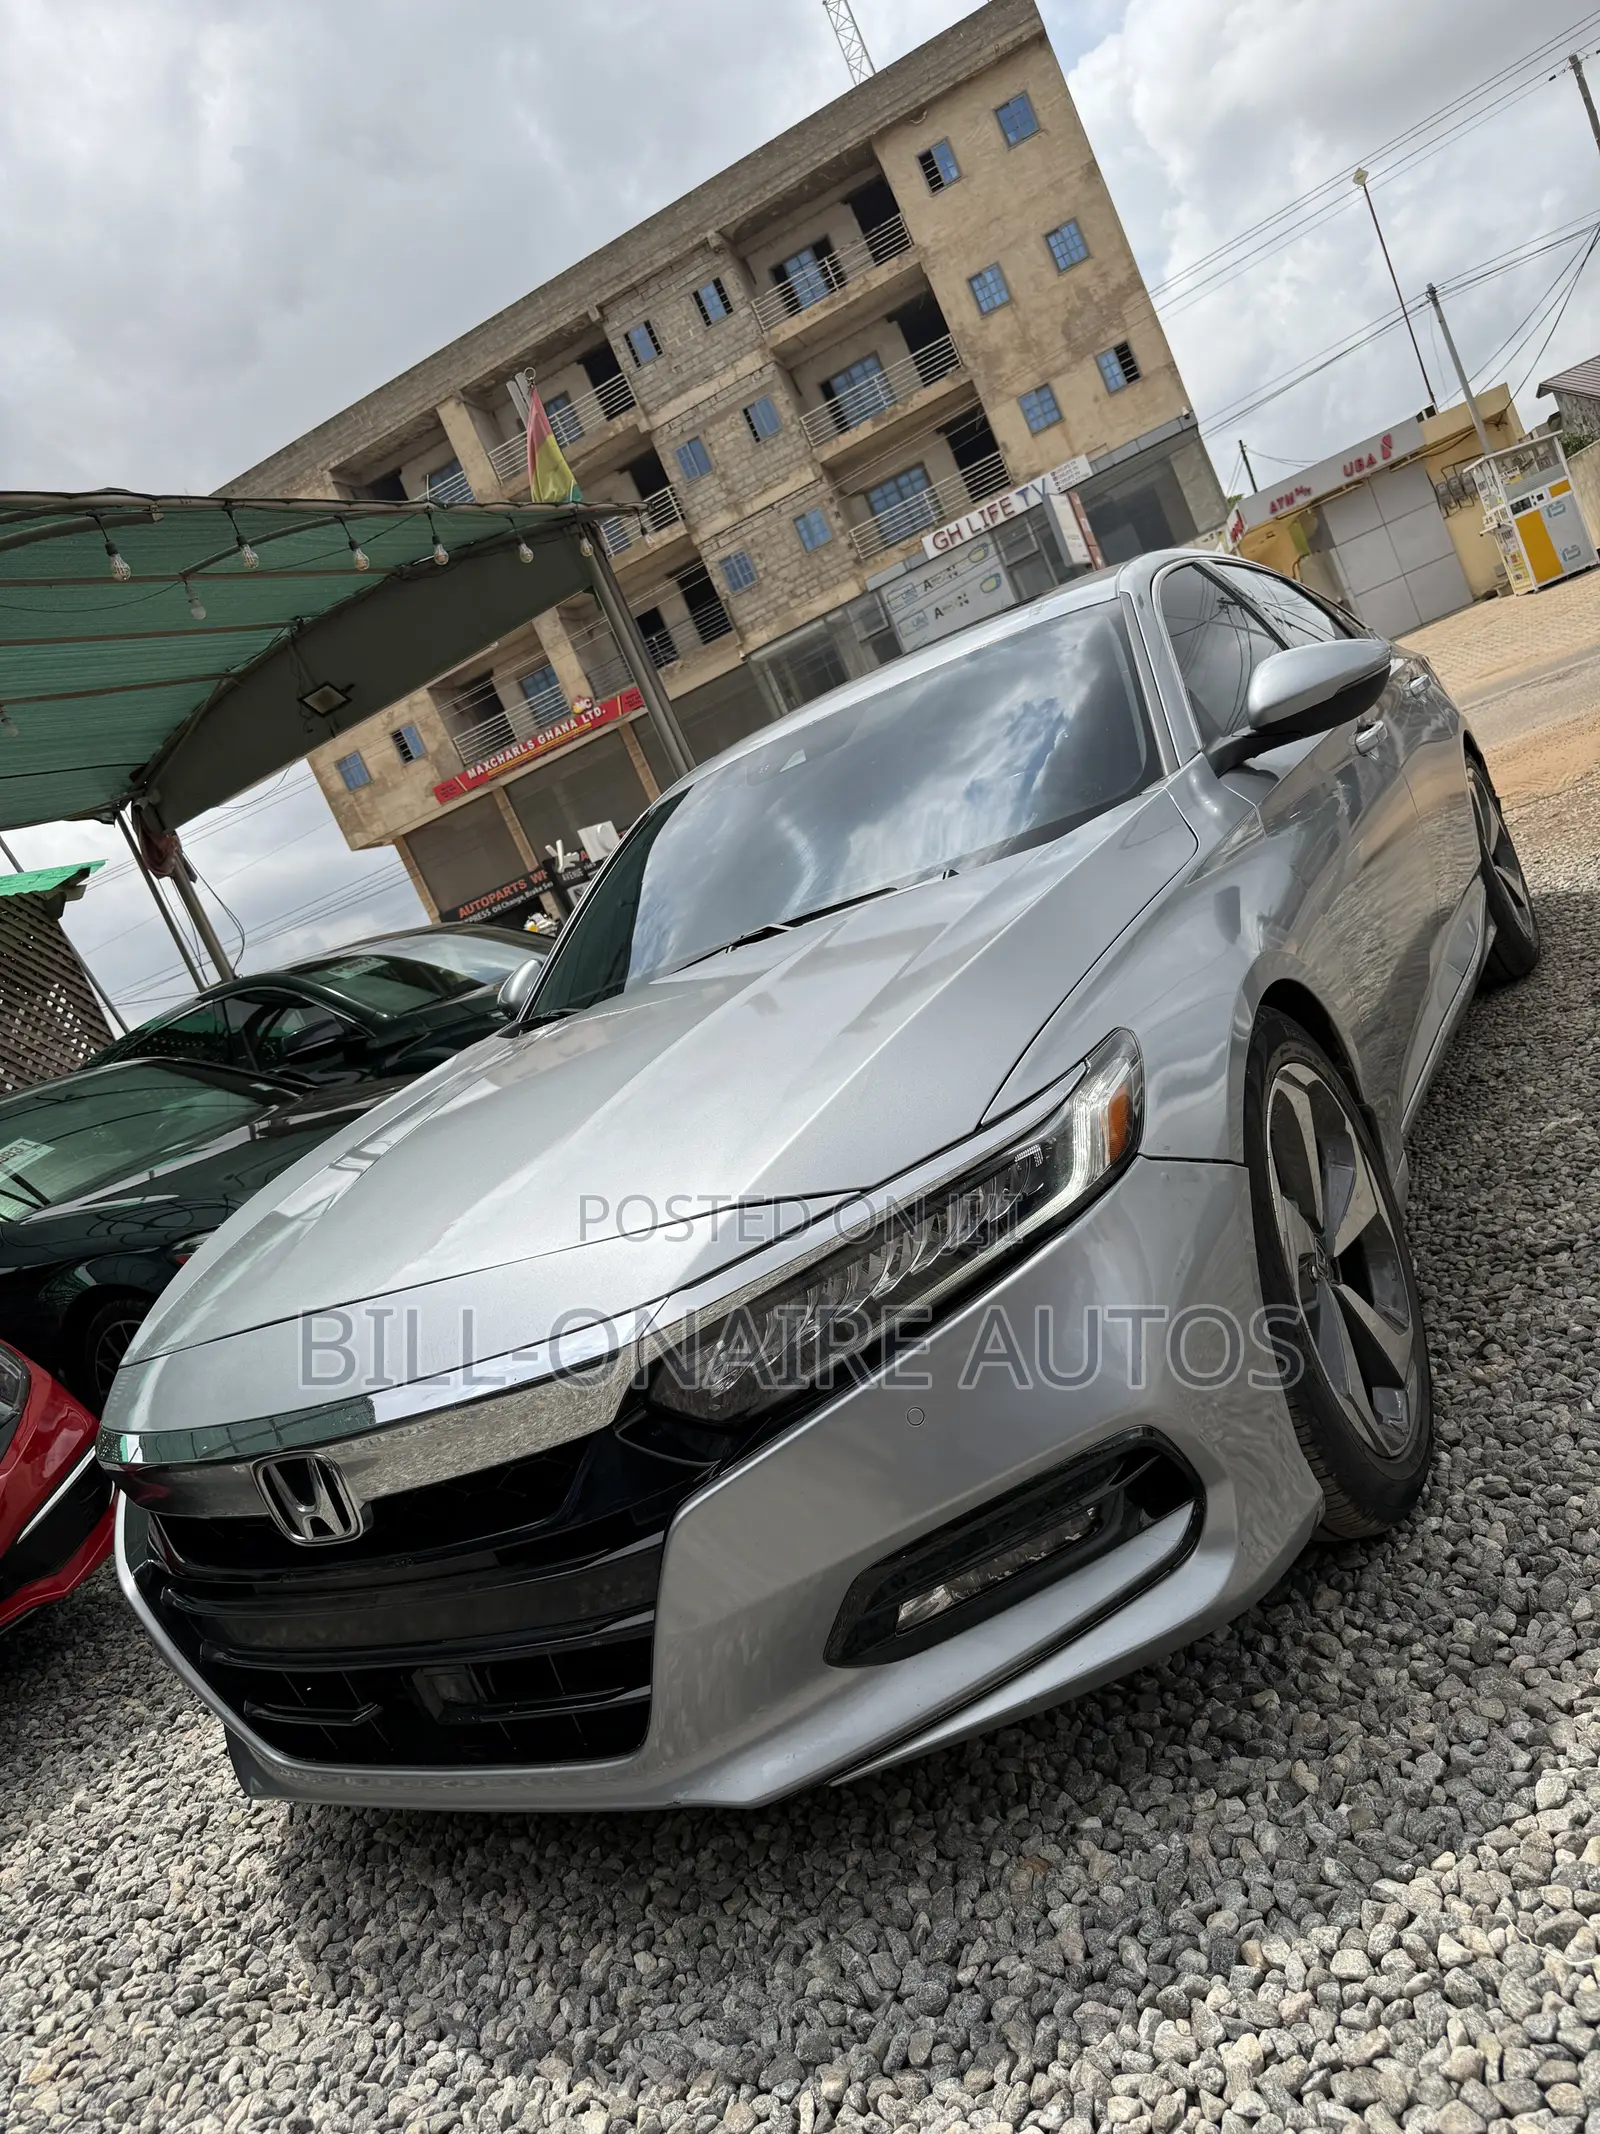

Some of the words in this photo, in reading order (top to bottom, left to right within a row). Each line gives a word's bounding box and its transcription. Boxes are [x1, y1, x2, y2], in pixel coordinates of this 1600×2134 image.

[1343, 452, 1377, 477] UBA
[932, 523, 964, 550] GH
[966, 496, 1015, 534] LIFE
[1015, 478, 1046, 507] TV
[1269, 492, 1295, 514] ATM
[467, 740, 535, 779] MAXCHARLS
[537, 719, 578, 744] GHANA
[580, 706, 606, 723] LTD.
[458, 879, 528, 919] AUTOPARTS
